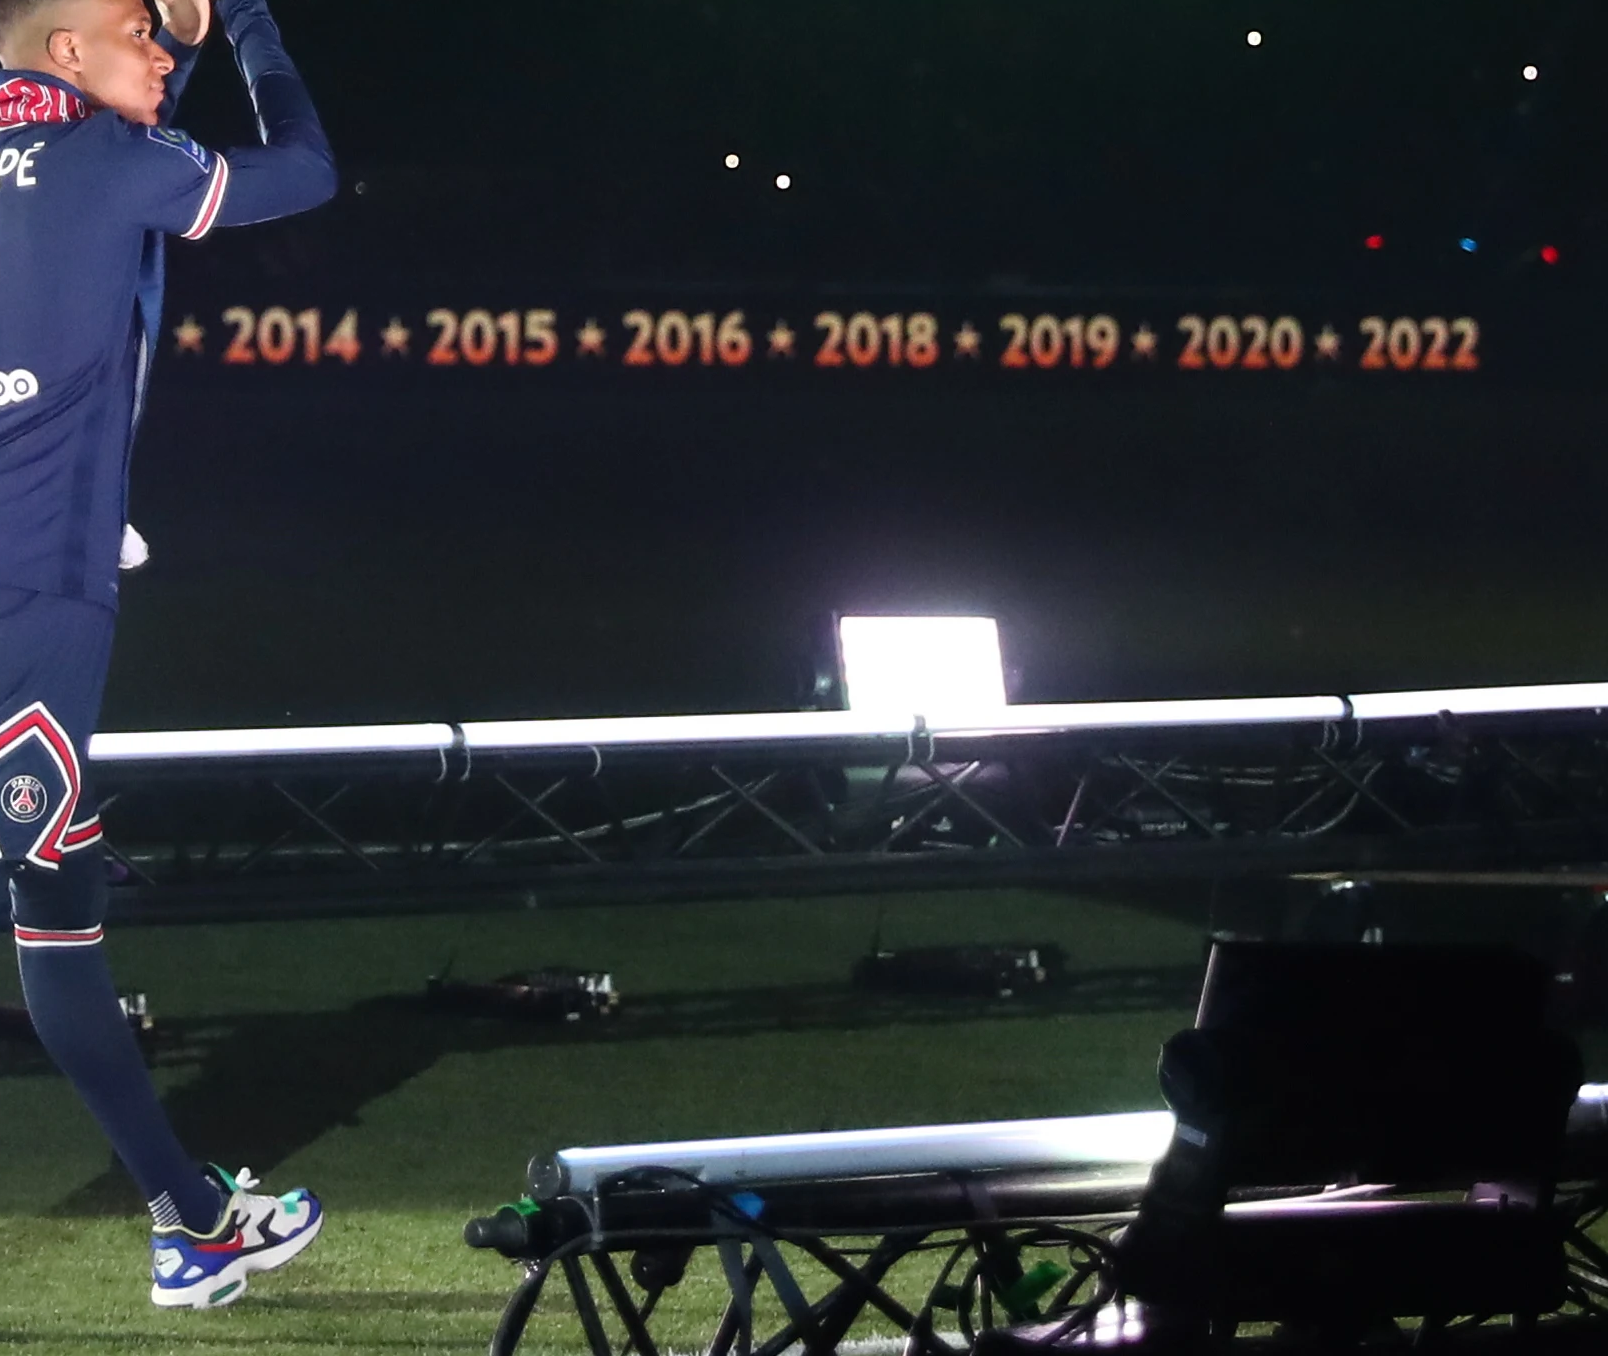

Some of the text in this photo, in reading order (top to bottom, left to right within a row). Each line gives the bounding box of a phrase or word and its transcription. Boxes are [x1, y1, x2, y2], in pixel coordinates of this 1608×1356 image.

[222, 306, 362, 364] 2014
[426, 307, 559, 366] 2015
[622, 309, 753, 366] 2016
[813, 311, 940, 368] 2018
[998, 313, 1120, 369] 2019
[1176, 314, 1304, 370] 2020
[1358, 315, 1480, 371] 2022
[10, 778, 41, 792] PARIS
